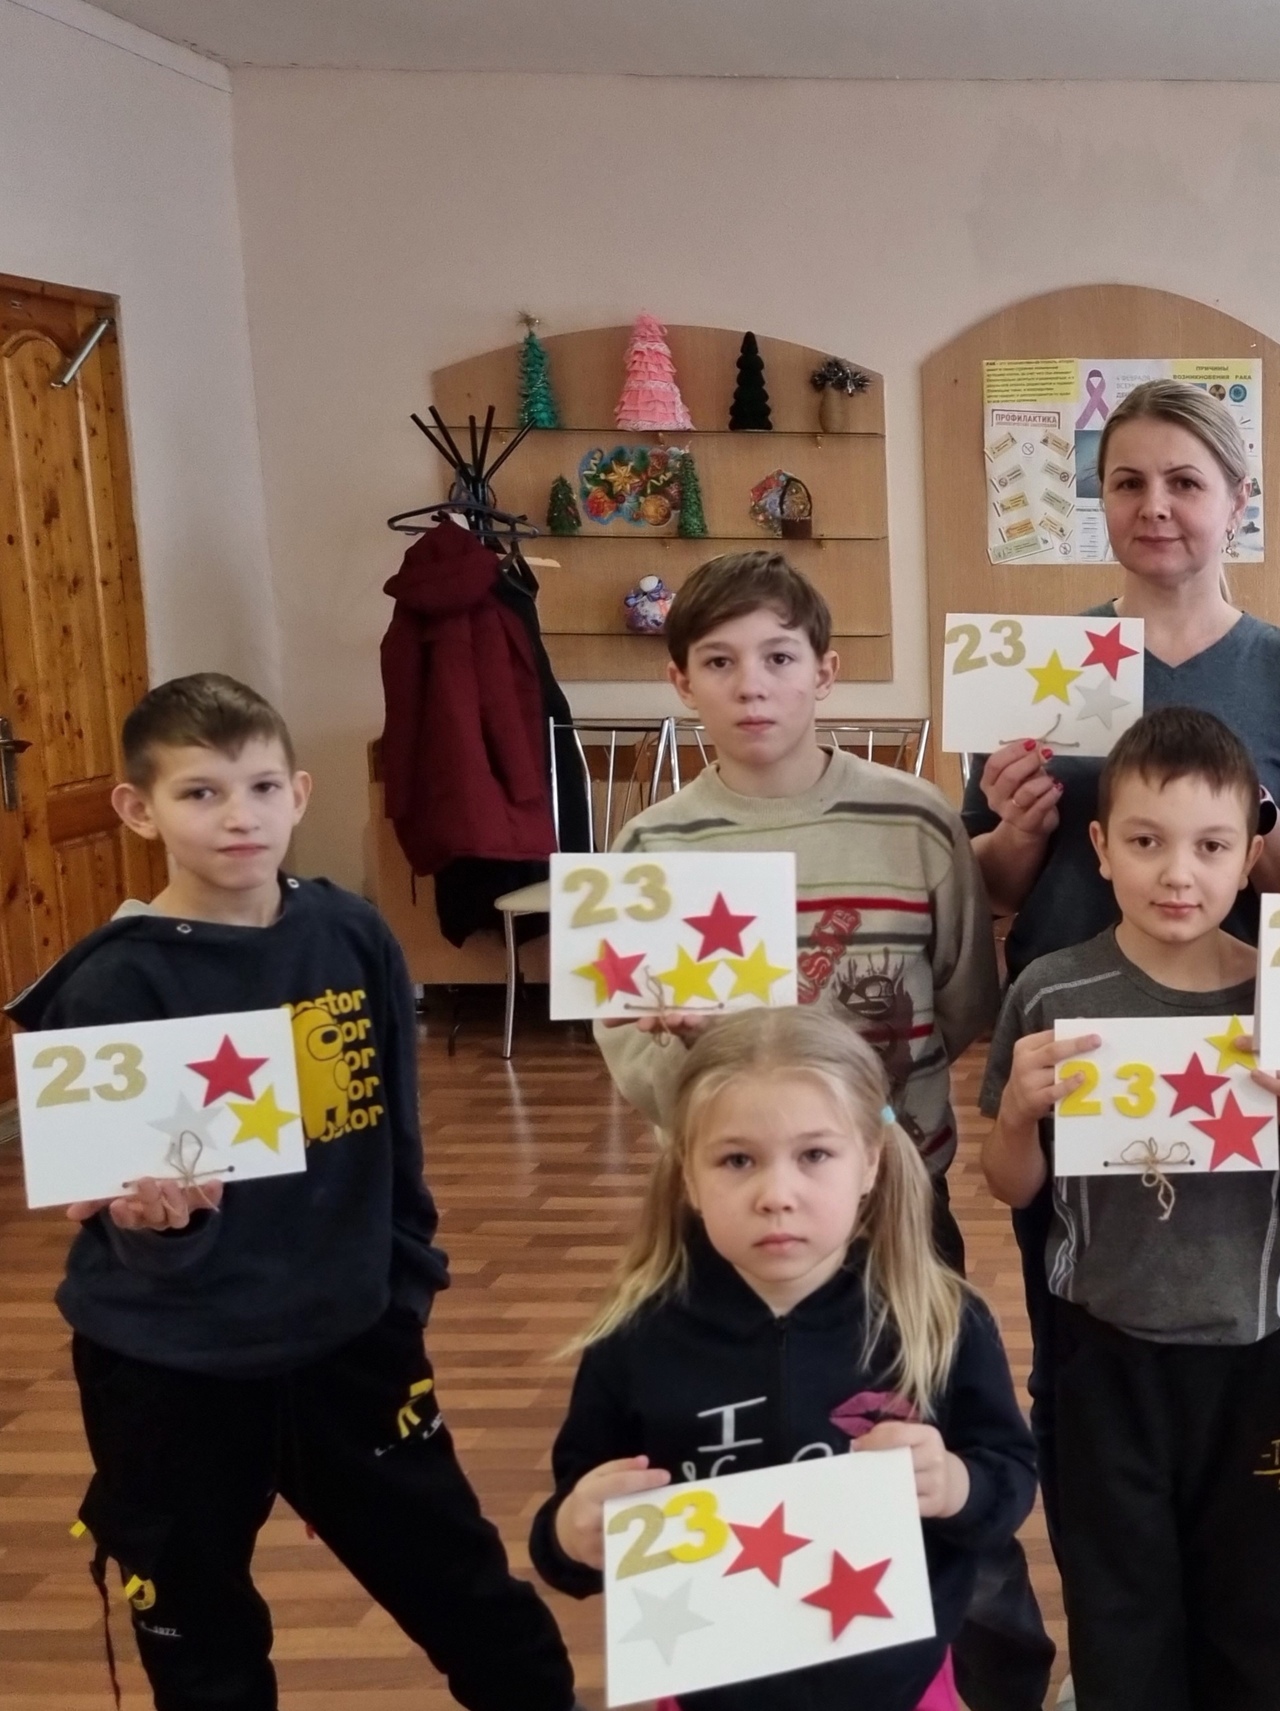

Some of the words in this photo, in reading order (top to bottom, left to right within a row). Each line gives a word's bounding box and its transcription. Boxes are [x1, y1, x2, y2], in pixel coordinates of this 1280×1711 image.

[995, 413, 1057, 423] ПРОФИЛАКТИКА
[945, 619, 1026, 675] 23
[562, 863, 673, 929] 23
[32, 1042, 147, 1108] 23
[1058, 1060, 1156, 1118] 23
[607, 1489, 729, 1580] 23
